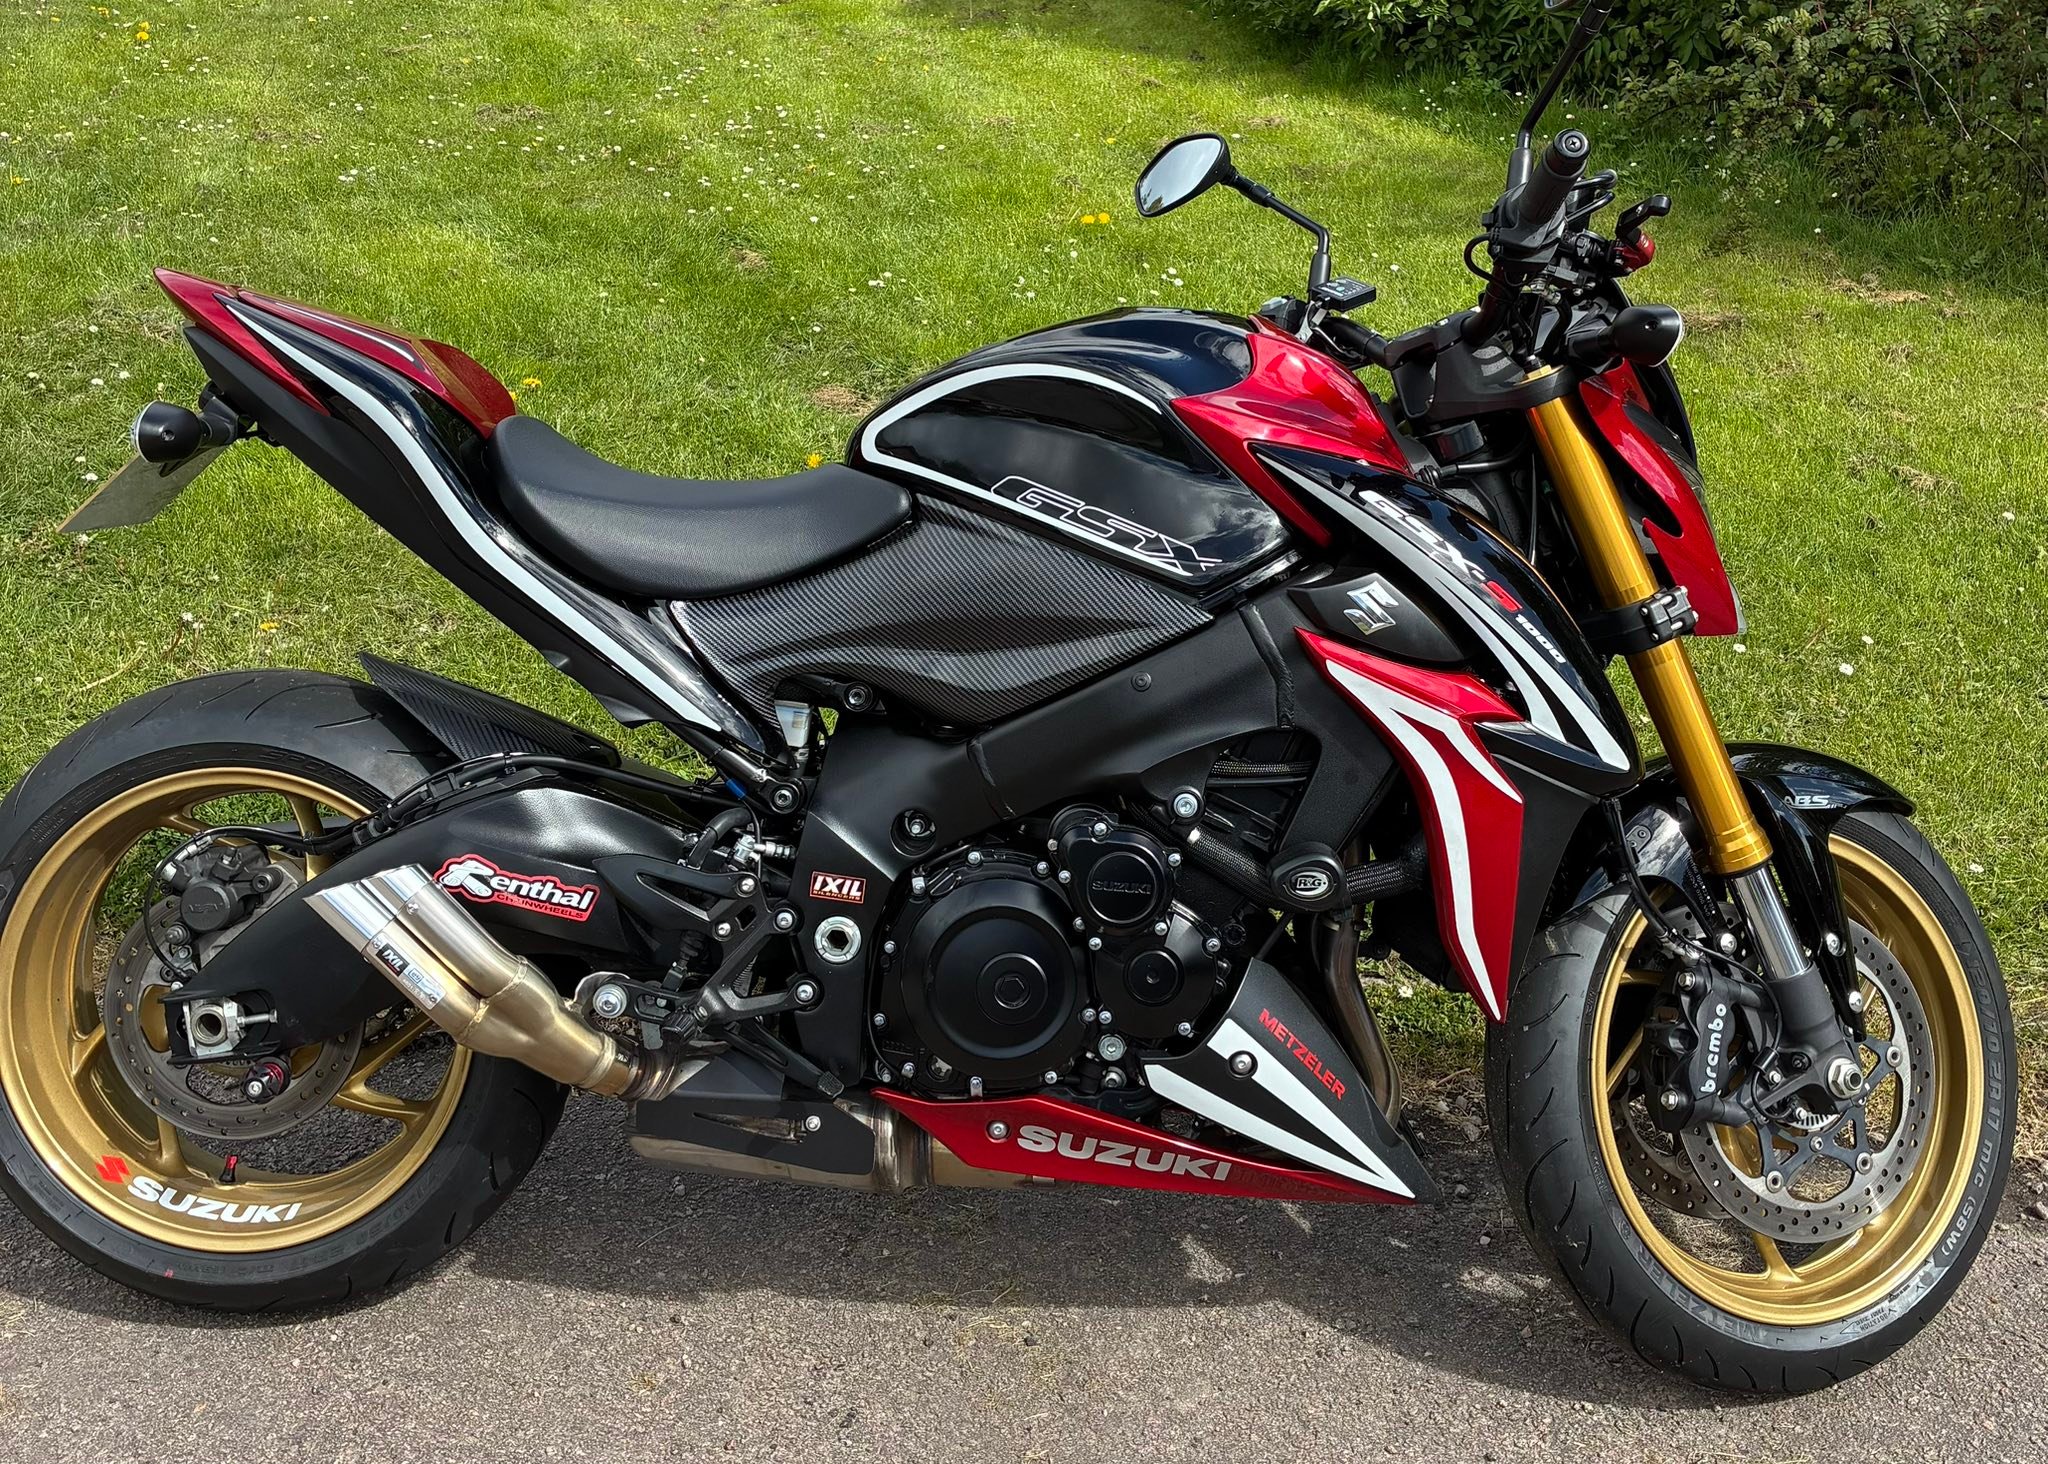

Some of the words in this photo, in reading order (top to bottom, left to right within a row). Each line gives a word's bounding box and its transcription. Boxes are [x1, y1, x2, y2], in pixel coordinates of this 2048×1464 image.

[991, 476, 1222, 575] GSX
[1515, 613, 1566, 663] 1000
[1783, 795, 1830, 809] ABS
[440, 859, 594, 910] Renthal
[813, 875, 862, 897] IXIL
[1092, 881, 1151, 895] SUZUKI
[1297, 877, 1322, 888] R&G
[381, 948, 404, 973] IXIL
[1257, 1008, 1348, 1100] METZELER
[1700, 1003, 1727, 1093] brembo
[1017, 1125, 1232, 1181] SUZUKI
[127, 1175, 302, 1223] SUZUKI
[1942, 1196, 1976, 1256] (58W)
[1635, 1245, 1767, 1341] METZELER
